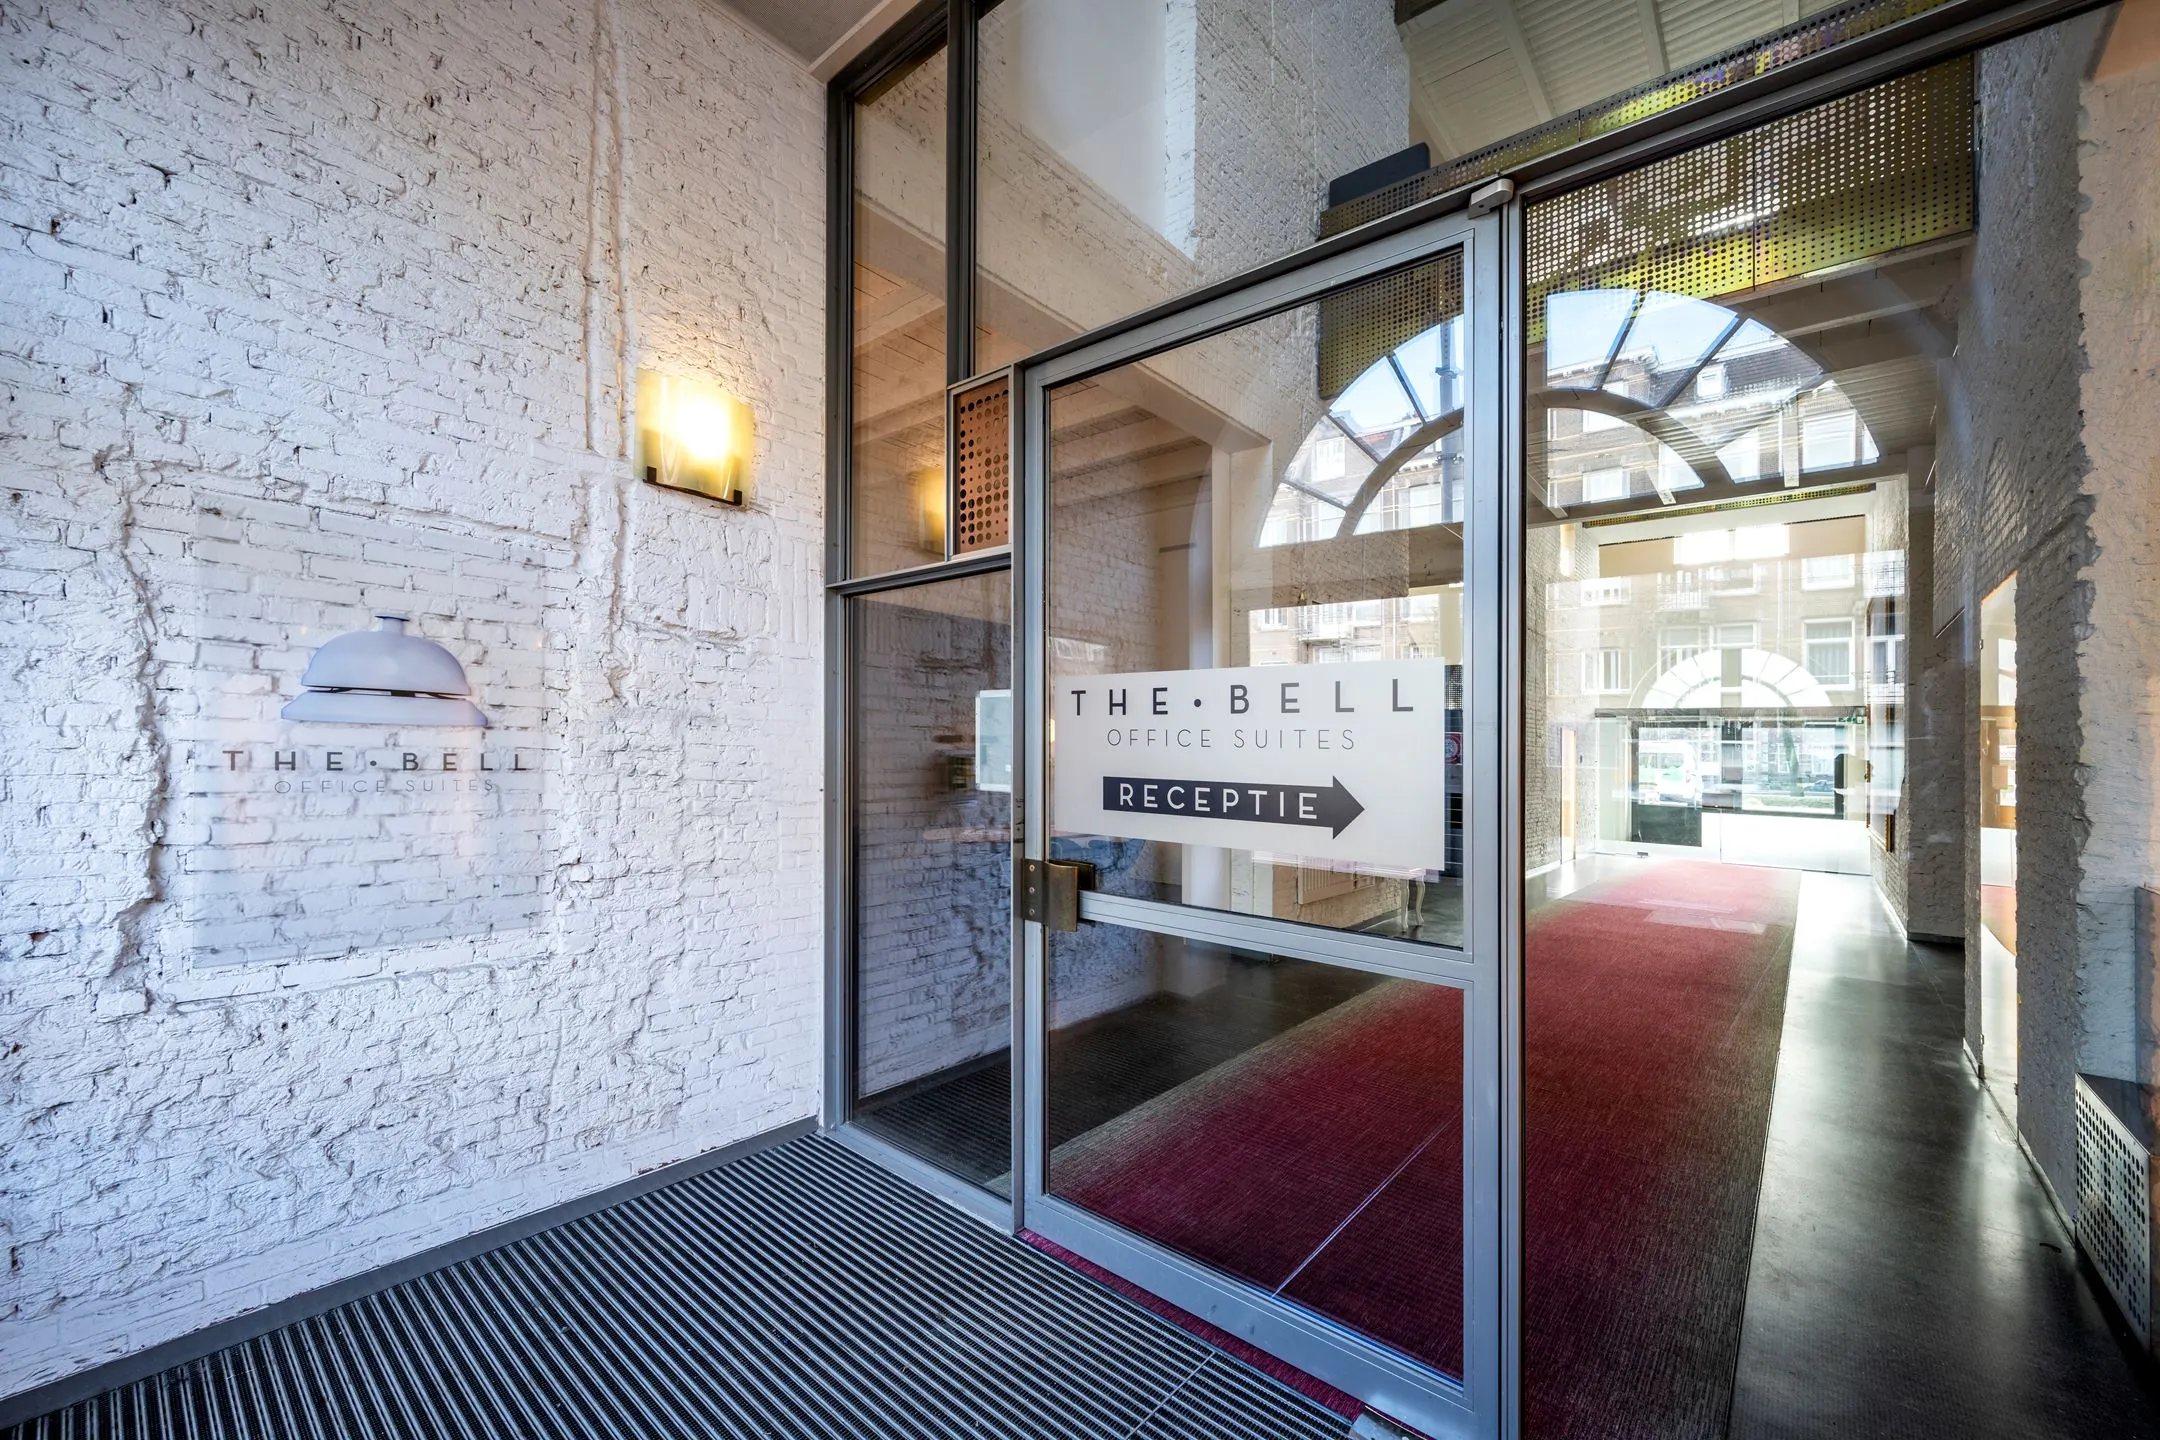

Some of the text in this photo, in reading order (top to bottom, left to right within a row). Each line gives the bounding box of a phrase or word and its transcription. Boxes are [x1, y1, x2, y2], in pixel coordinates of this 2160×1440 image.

[1070, 678, 1414, 716] THE BELL
[1107, 729, 1355, 750] OFFICE SUITES
[222, 750, 529, 772] THE BELL
[273, 778, 494, 793] OFFICE SUITES
[1119, 783, 1318, 819] RECEPTIE
